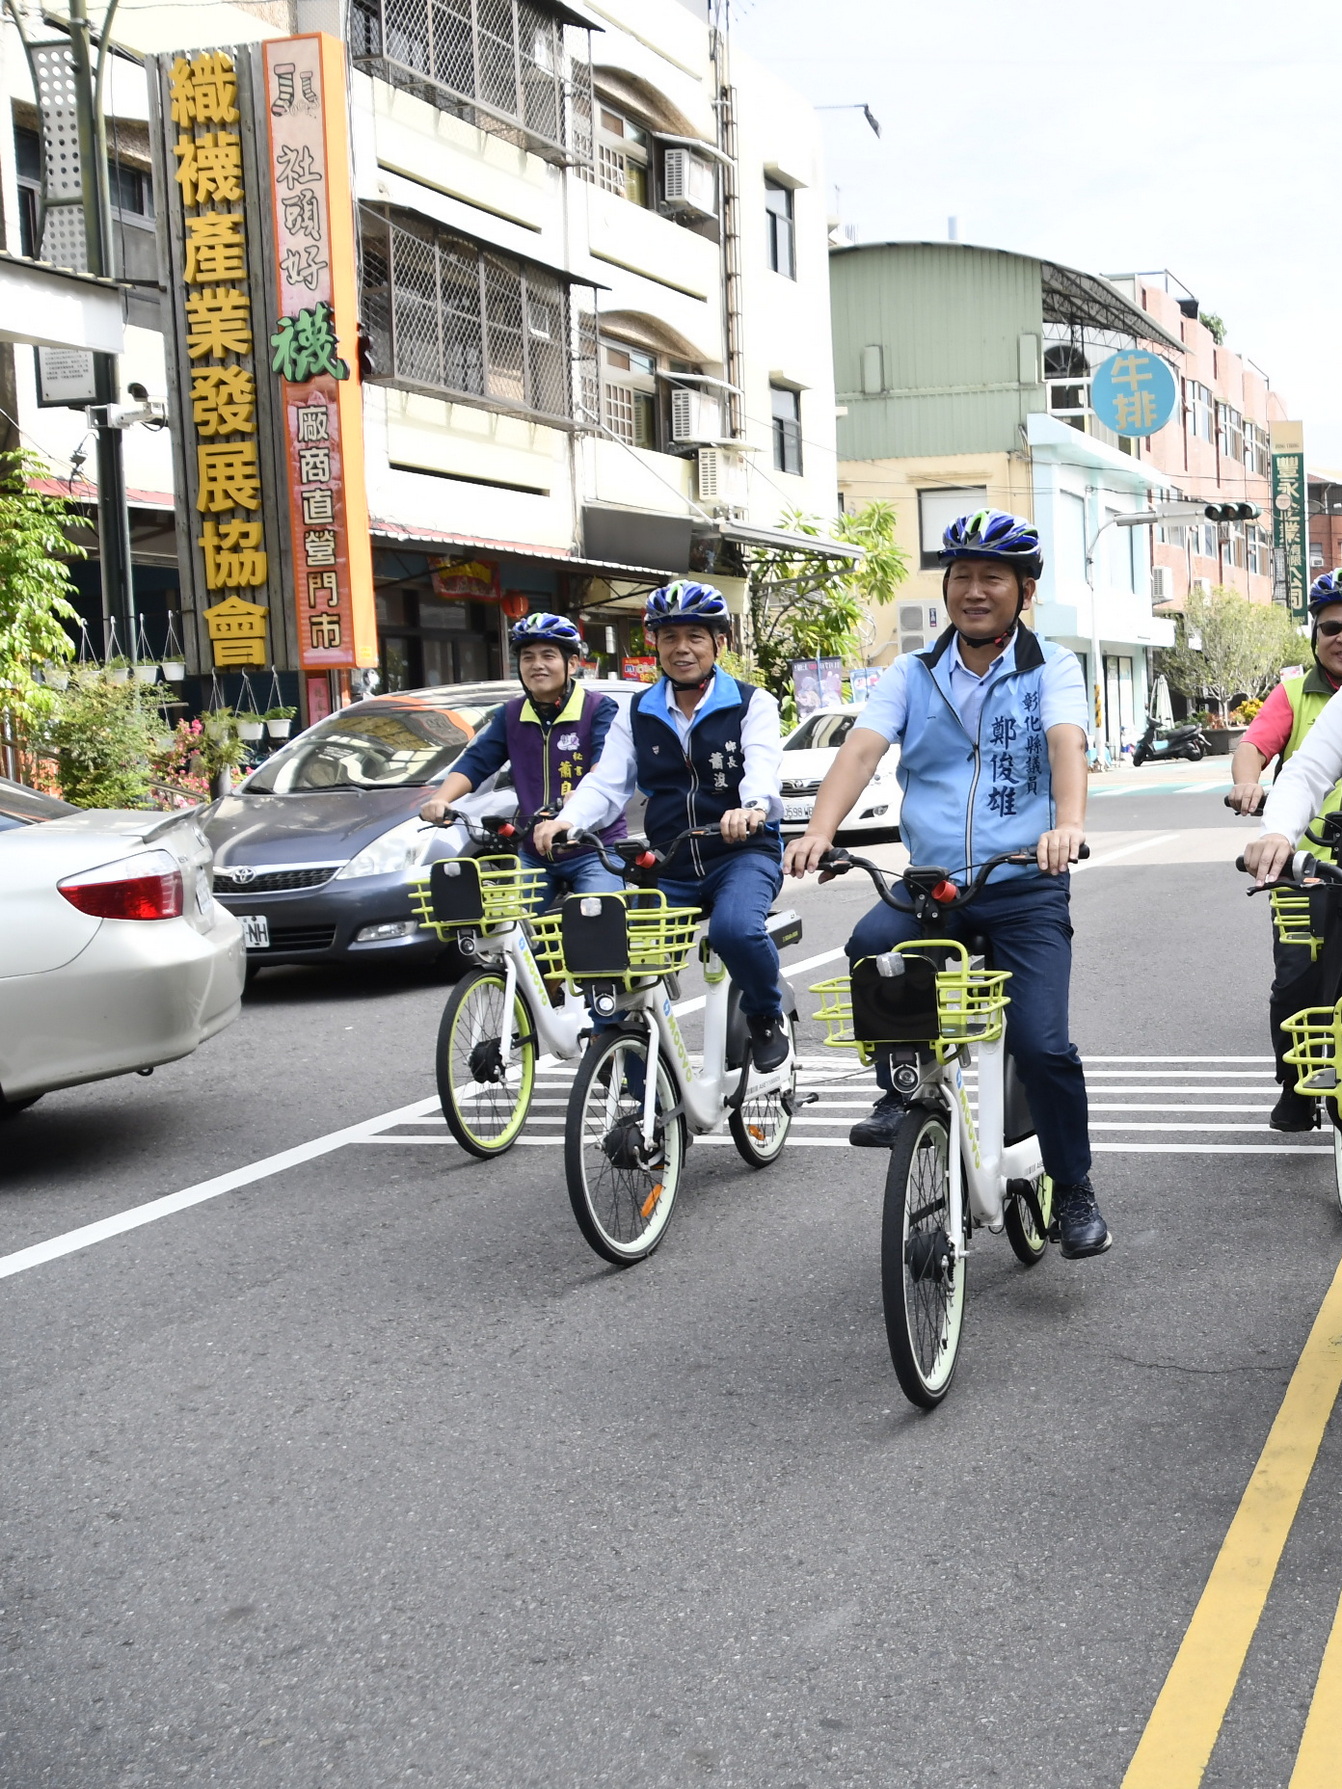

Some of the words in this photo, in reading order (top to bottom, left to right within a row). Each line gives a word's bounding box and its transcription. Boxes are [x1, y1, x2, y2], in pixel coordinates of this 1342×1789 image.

[271, 145, 346, 381] 社頭好襪
[169, 51, 270, 667] 織襪產業發展協會
[1110, 355, 1158, 430] 牛排
[297, 404, 342, 650] 廠商直營門市
[708, 751, 729, 791] 蕭浚
[987, 715, 1019, 818] 鄭俊雄
[1022, 691, 1042, 796] 彰化縣議員
[522, 947, 548, 1006] MOOVO
[667, 1014, 692, 1083] MOOVO
